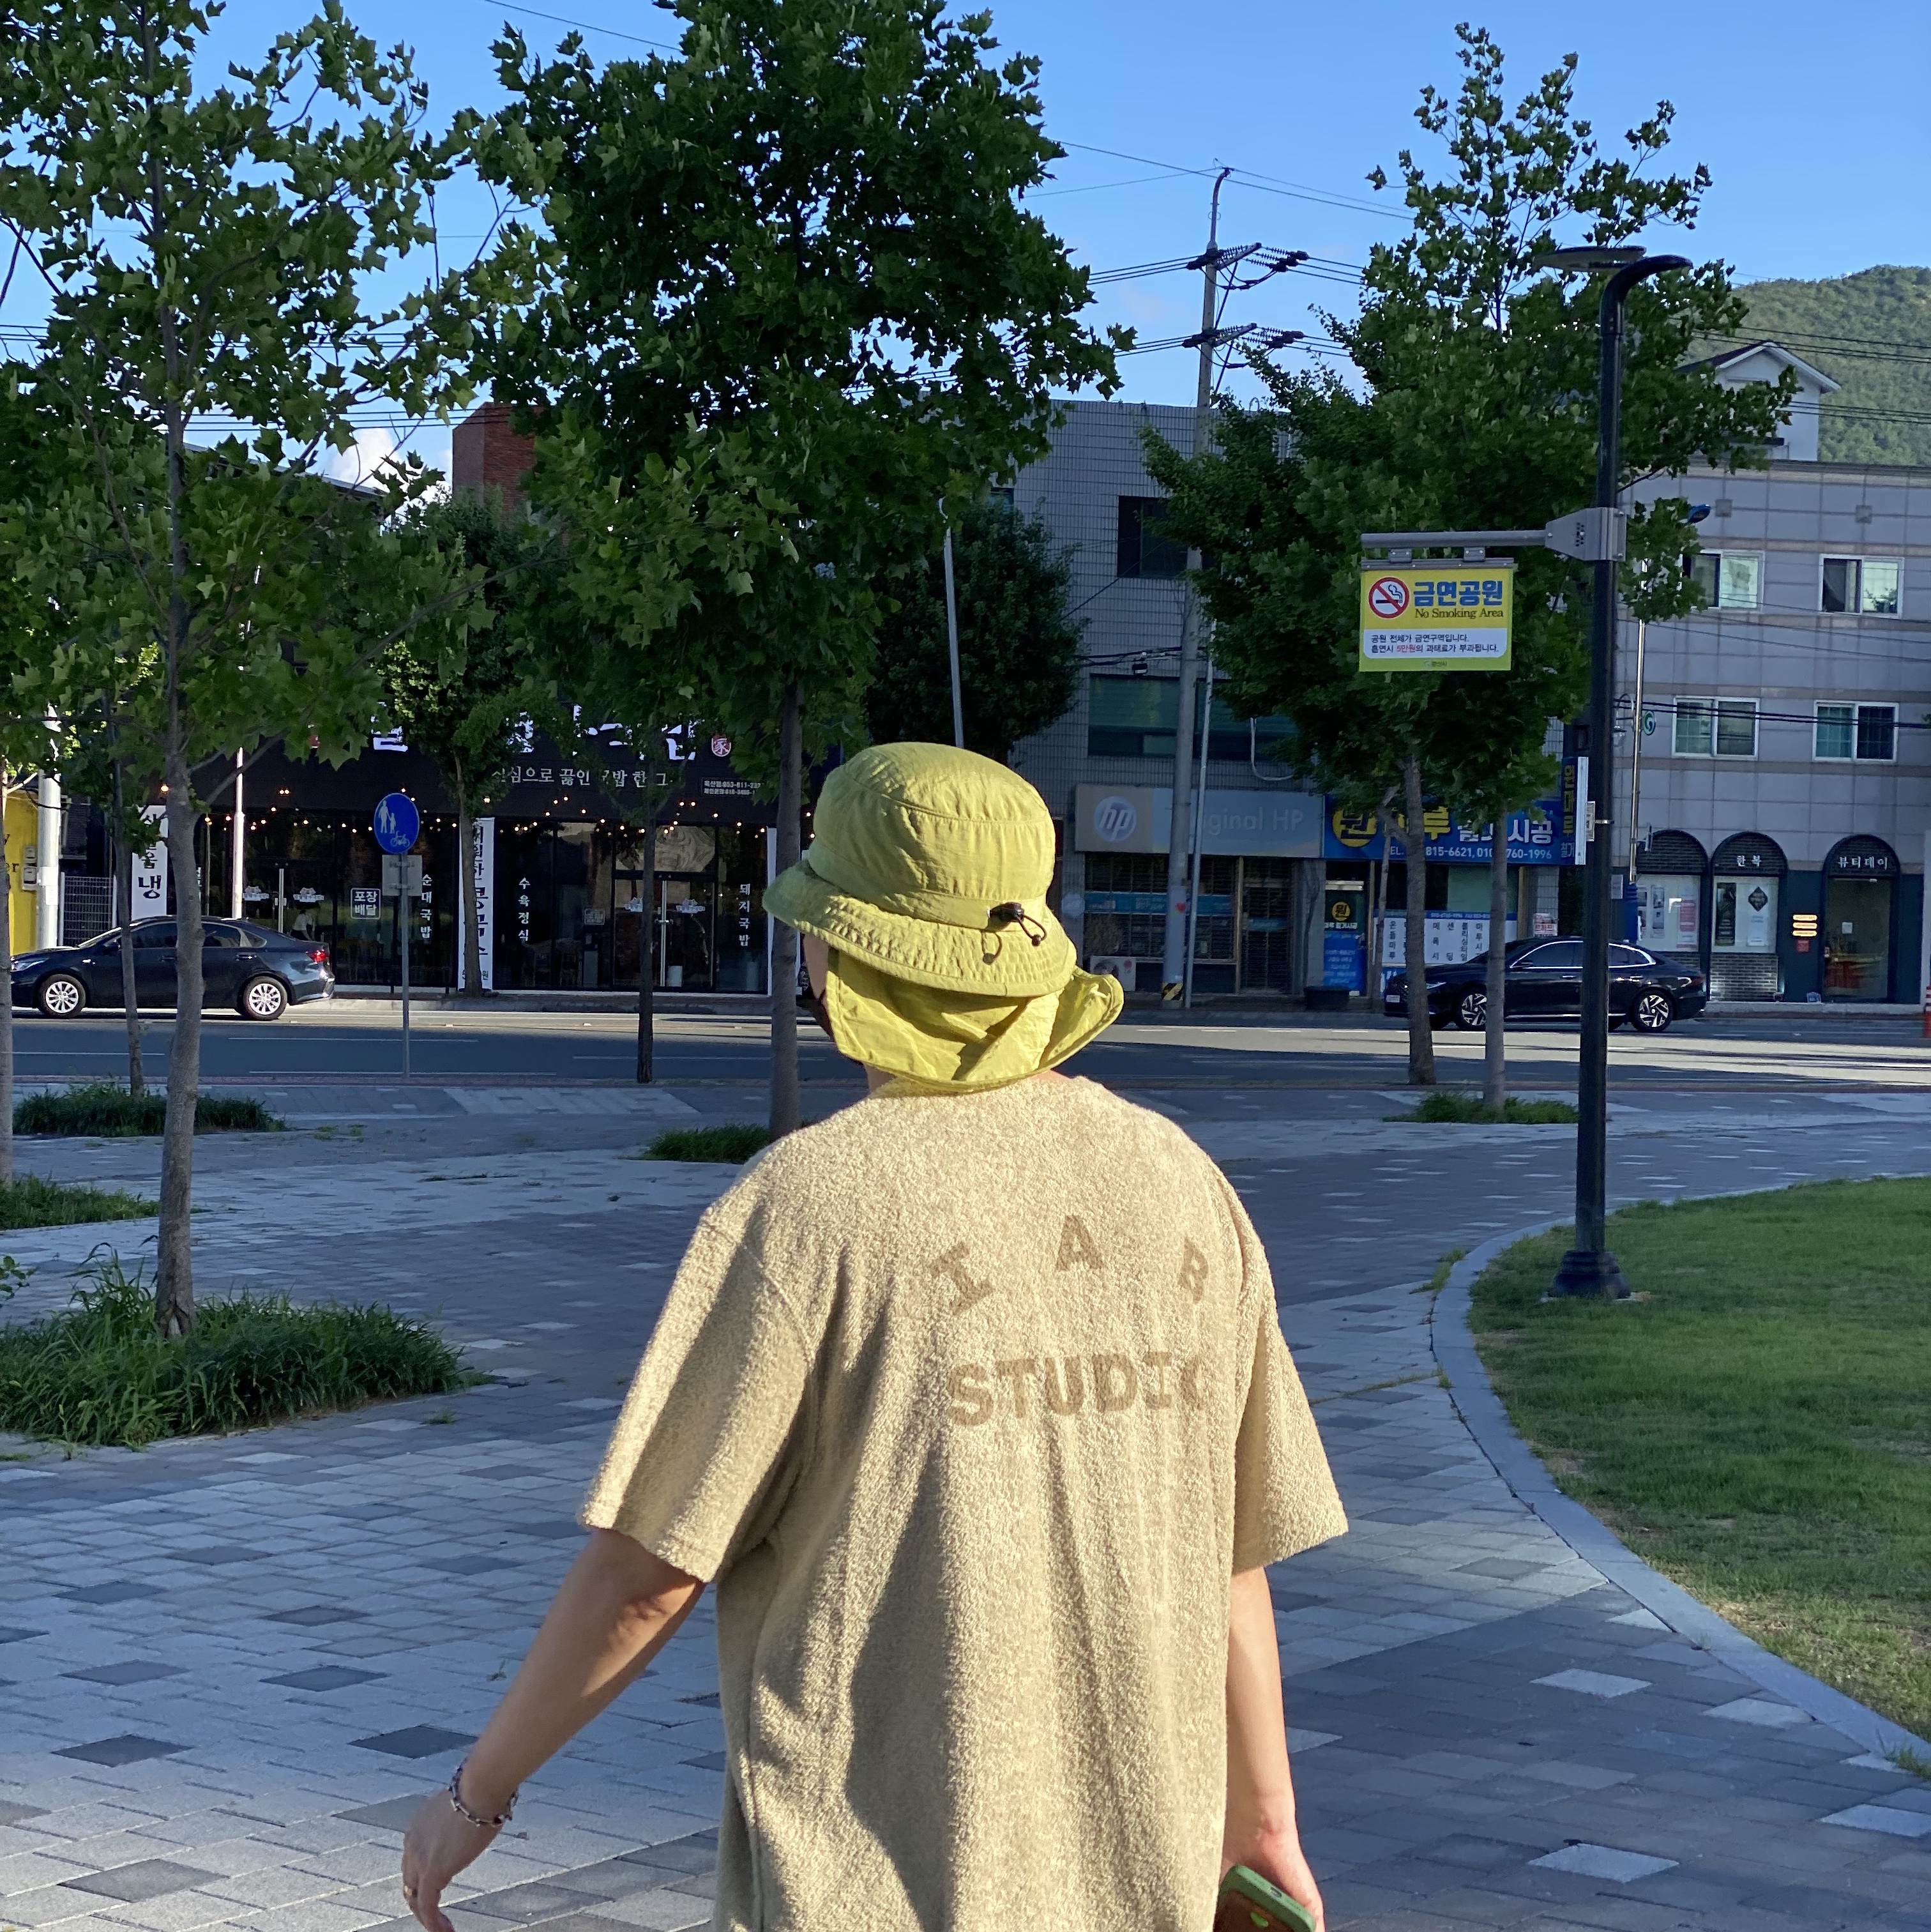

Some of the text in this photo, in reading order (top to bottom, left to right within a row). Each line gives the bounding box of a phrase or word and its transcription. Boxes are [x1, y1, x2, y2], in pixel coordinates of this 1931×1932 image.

[1413, 580, 1503, 607] 금연공원
[1414, 608, 1504, 620] No Smoking Area
[1371, 634, 1469, 643] 공원 전체가 금연구역입니다.
[1371, 644, 1393, 653] 흡연시
[1397, 644, 1423, 653] 5만원의
[1426, 644, 1456, 653] 과태료가
[559, 768, 590, 786] 끓인
[632, 770, 647, 788] 한
[1098, 800, 1134, 841] hp
[1204, 805, 1304, 835] iginal HP
[1508, 819, 1553, 844] 시공
[1838, 856, 1888, 870] 뷰티데이
[354, 891, 377, 902] 포장
[420, 874, 433, 939] 순대국밥
[517, 877, 531, 941] 수육정식
[354, 904, 377, 917] 배달
[738, 883, 751, 947] 돼지국밥
[1475, 923, 1483, 955] 마루시
